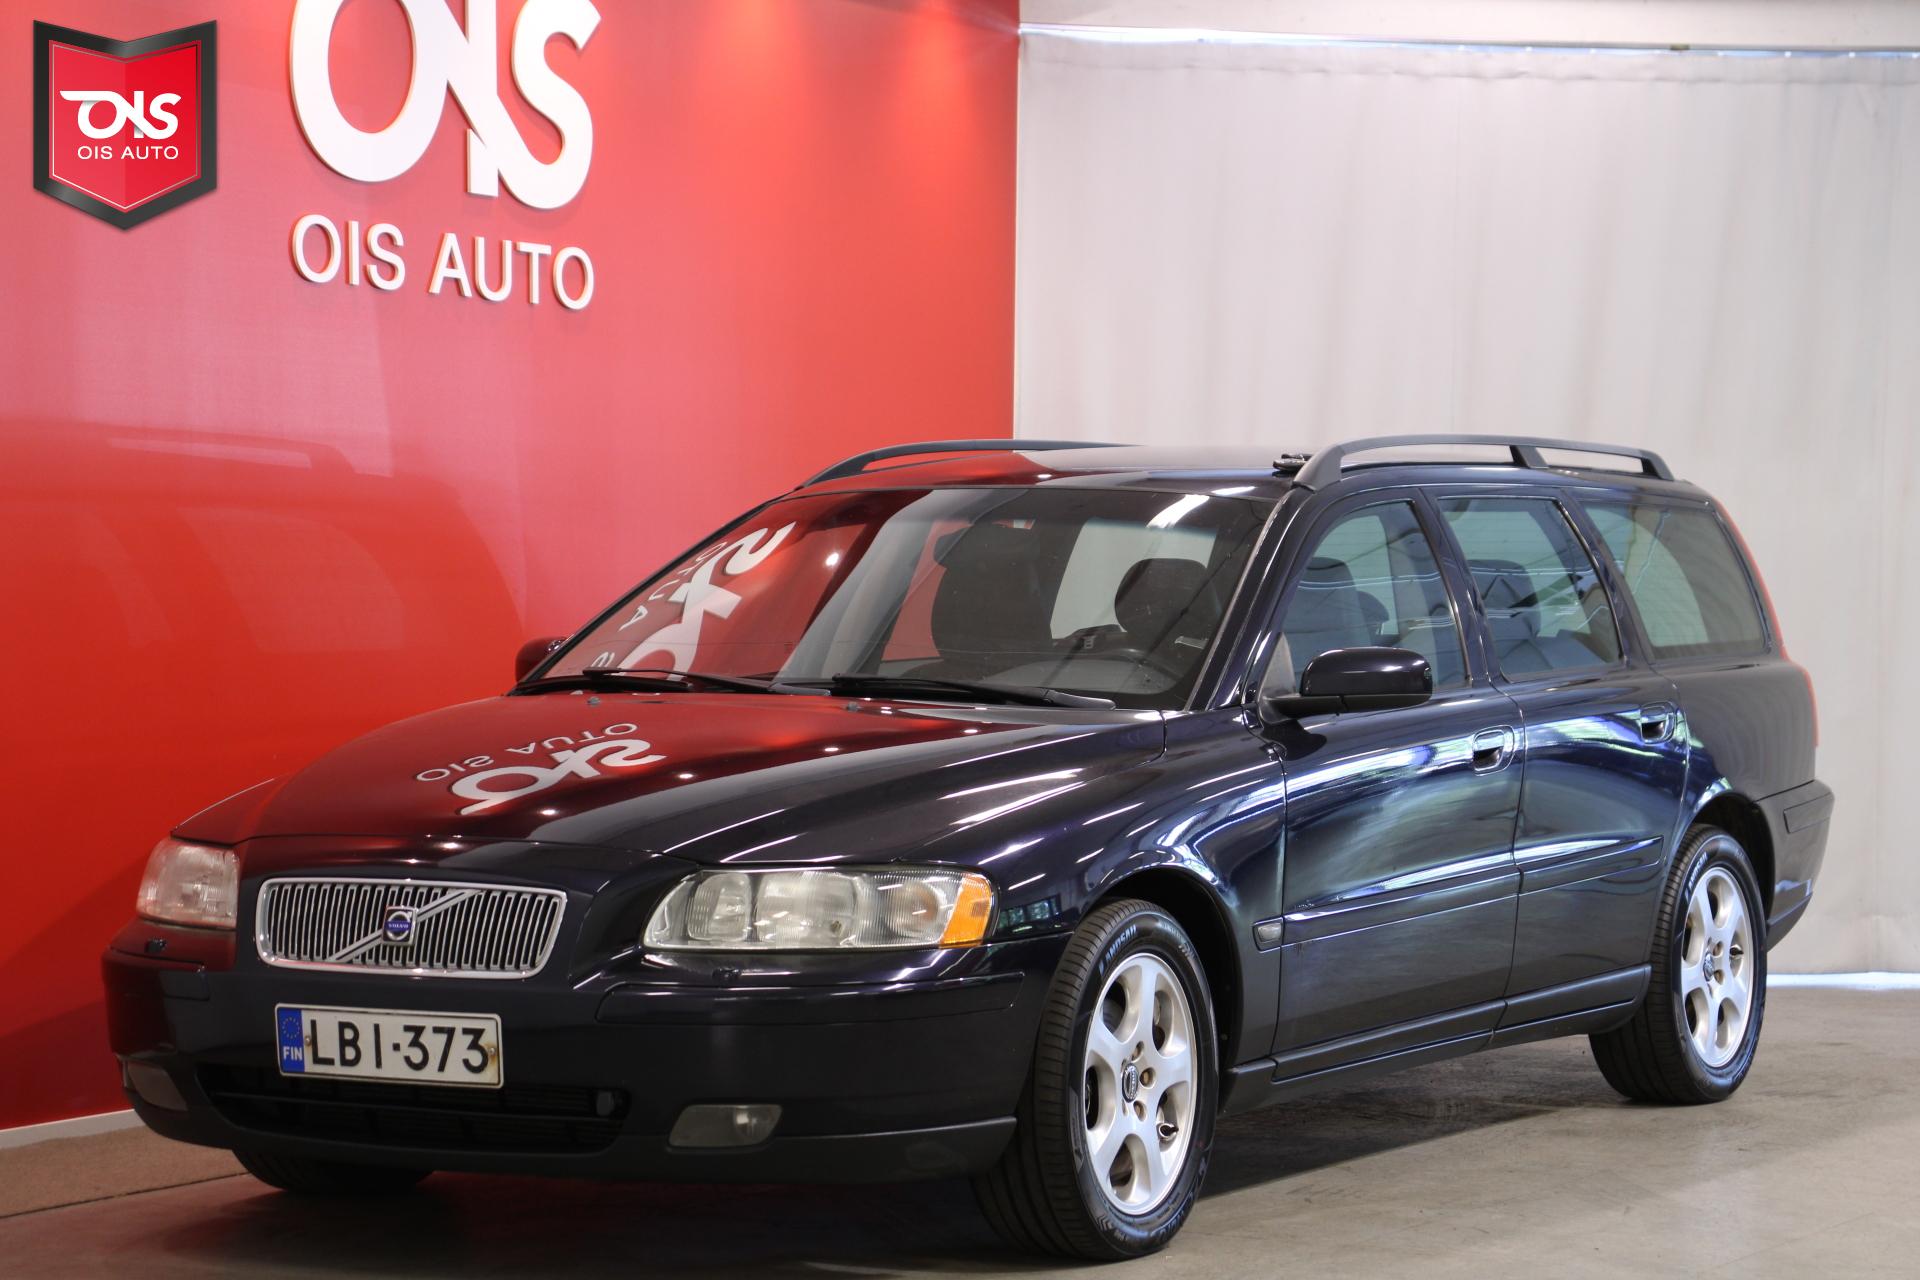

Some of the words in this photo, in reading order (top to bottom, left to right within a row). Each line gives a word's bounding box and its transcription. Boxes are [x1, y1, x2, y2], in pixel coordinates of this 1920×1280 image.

[291, 214, 405, 291] OIS
[429, 232, 595, 310] AUTO
[283, 1046, 303, 1062] FIN
[310, 1019, 489, 1074] LBI-373
